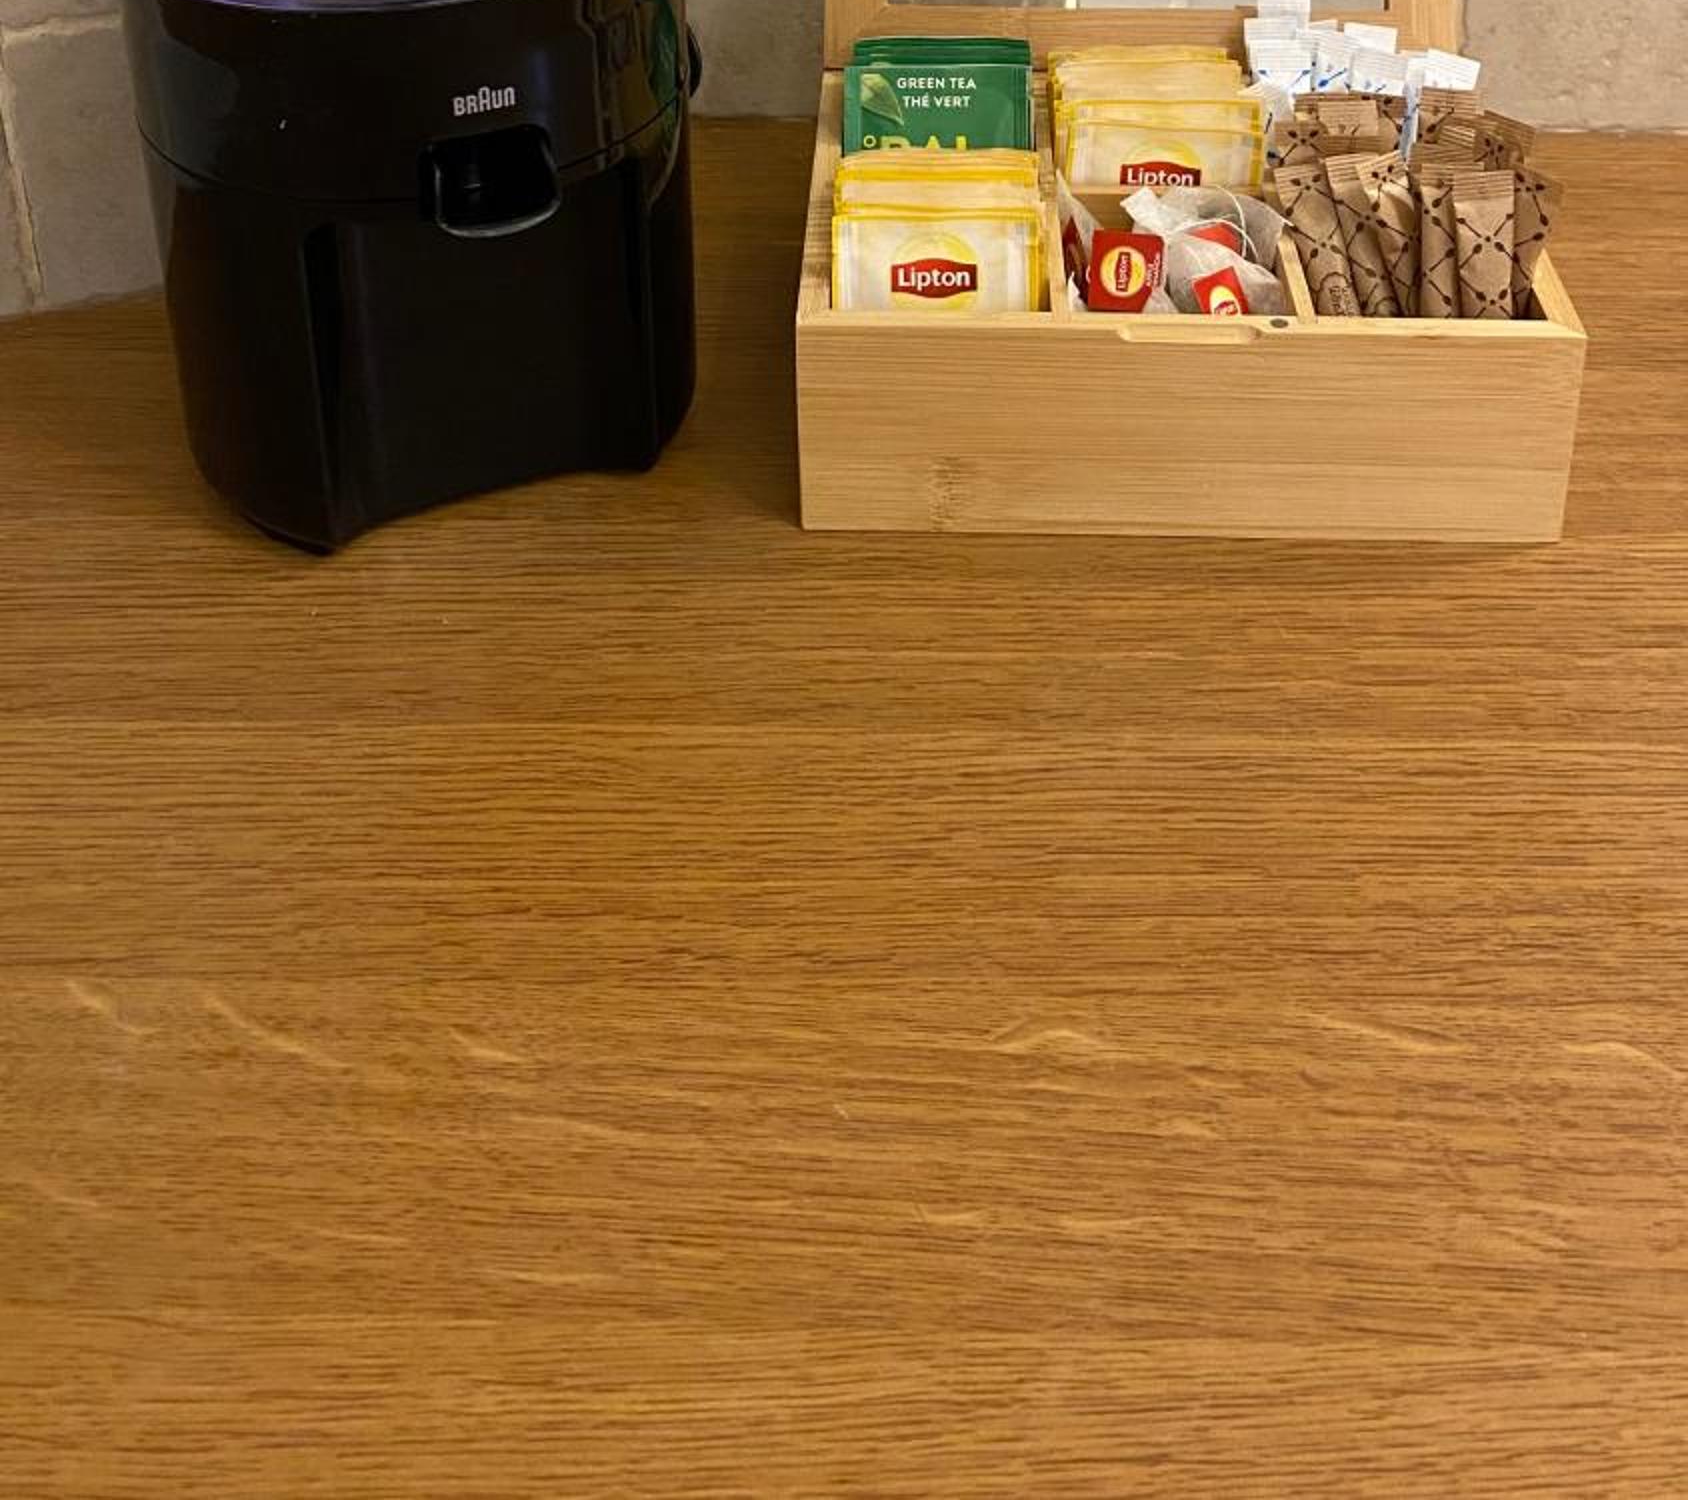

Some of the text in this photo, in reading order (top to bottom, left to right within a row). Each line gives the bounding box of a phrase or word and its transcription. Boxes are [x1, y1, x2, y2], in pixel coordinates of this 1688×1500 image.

[896, 77, 977, 90] GREEN TEA
[453, 85, 516, 117] BRAUN
[902, 92, 971, 108] THÉ VERT
[1127, 167, 1194, 188] Lipton
[897, 265, 971, 292] Lipton
